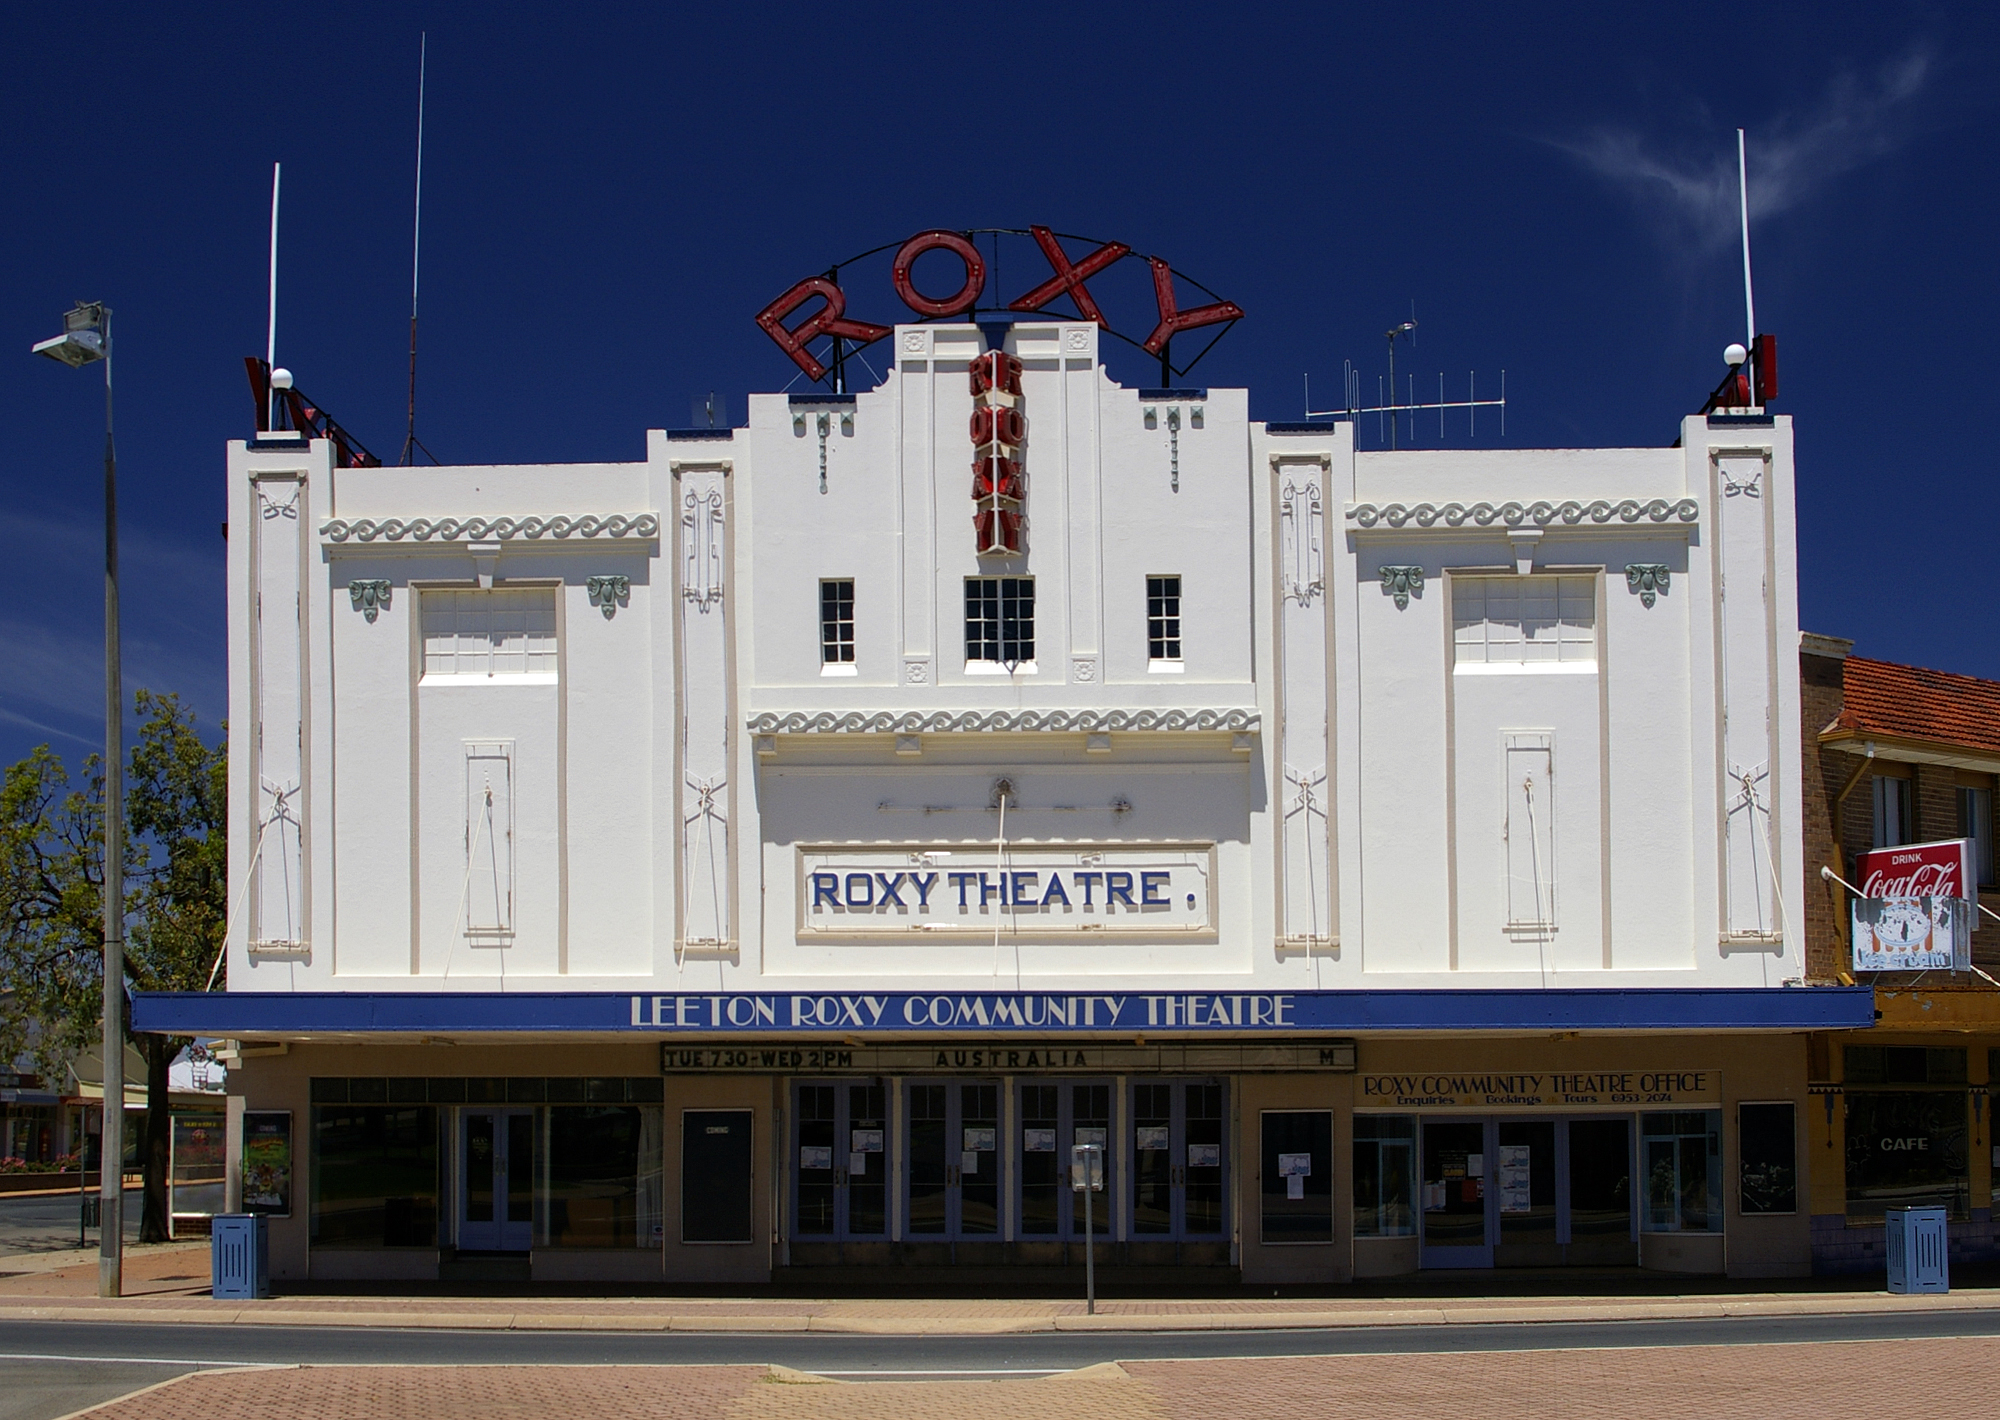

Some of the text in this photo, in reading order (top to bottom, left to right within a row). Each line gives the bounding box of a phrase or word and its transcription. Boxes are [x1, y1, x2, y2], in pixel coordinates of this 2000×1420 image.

[755, 225, 1244, 382] ROXY
[1891, 853, 1923, 866] DRINK
[813, 871, 1171, 907] ROXY THEATRE
[631, 995, 1297, 1027] LEETON ROXY COMMUNITY THEATRE
[666, 1051, 703, 1067] TUE
[936, 1050, 1087, 1067] AUSTRALIA
[1320, 1050, 1334, 1065] M
[1364, 1073, 1706, 1096] ROXY COMMUNITY THEATRE OFFICE
[1397, 1095, 1455, 1106] Enquiries
[1486, 1094, 1541, 1105] Bookings
[1563, 1094, 1598, 1103] Tours
[1880, 1137, 1929, 1151] CAFE
